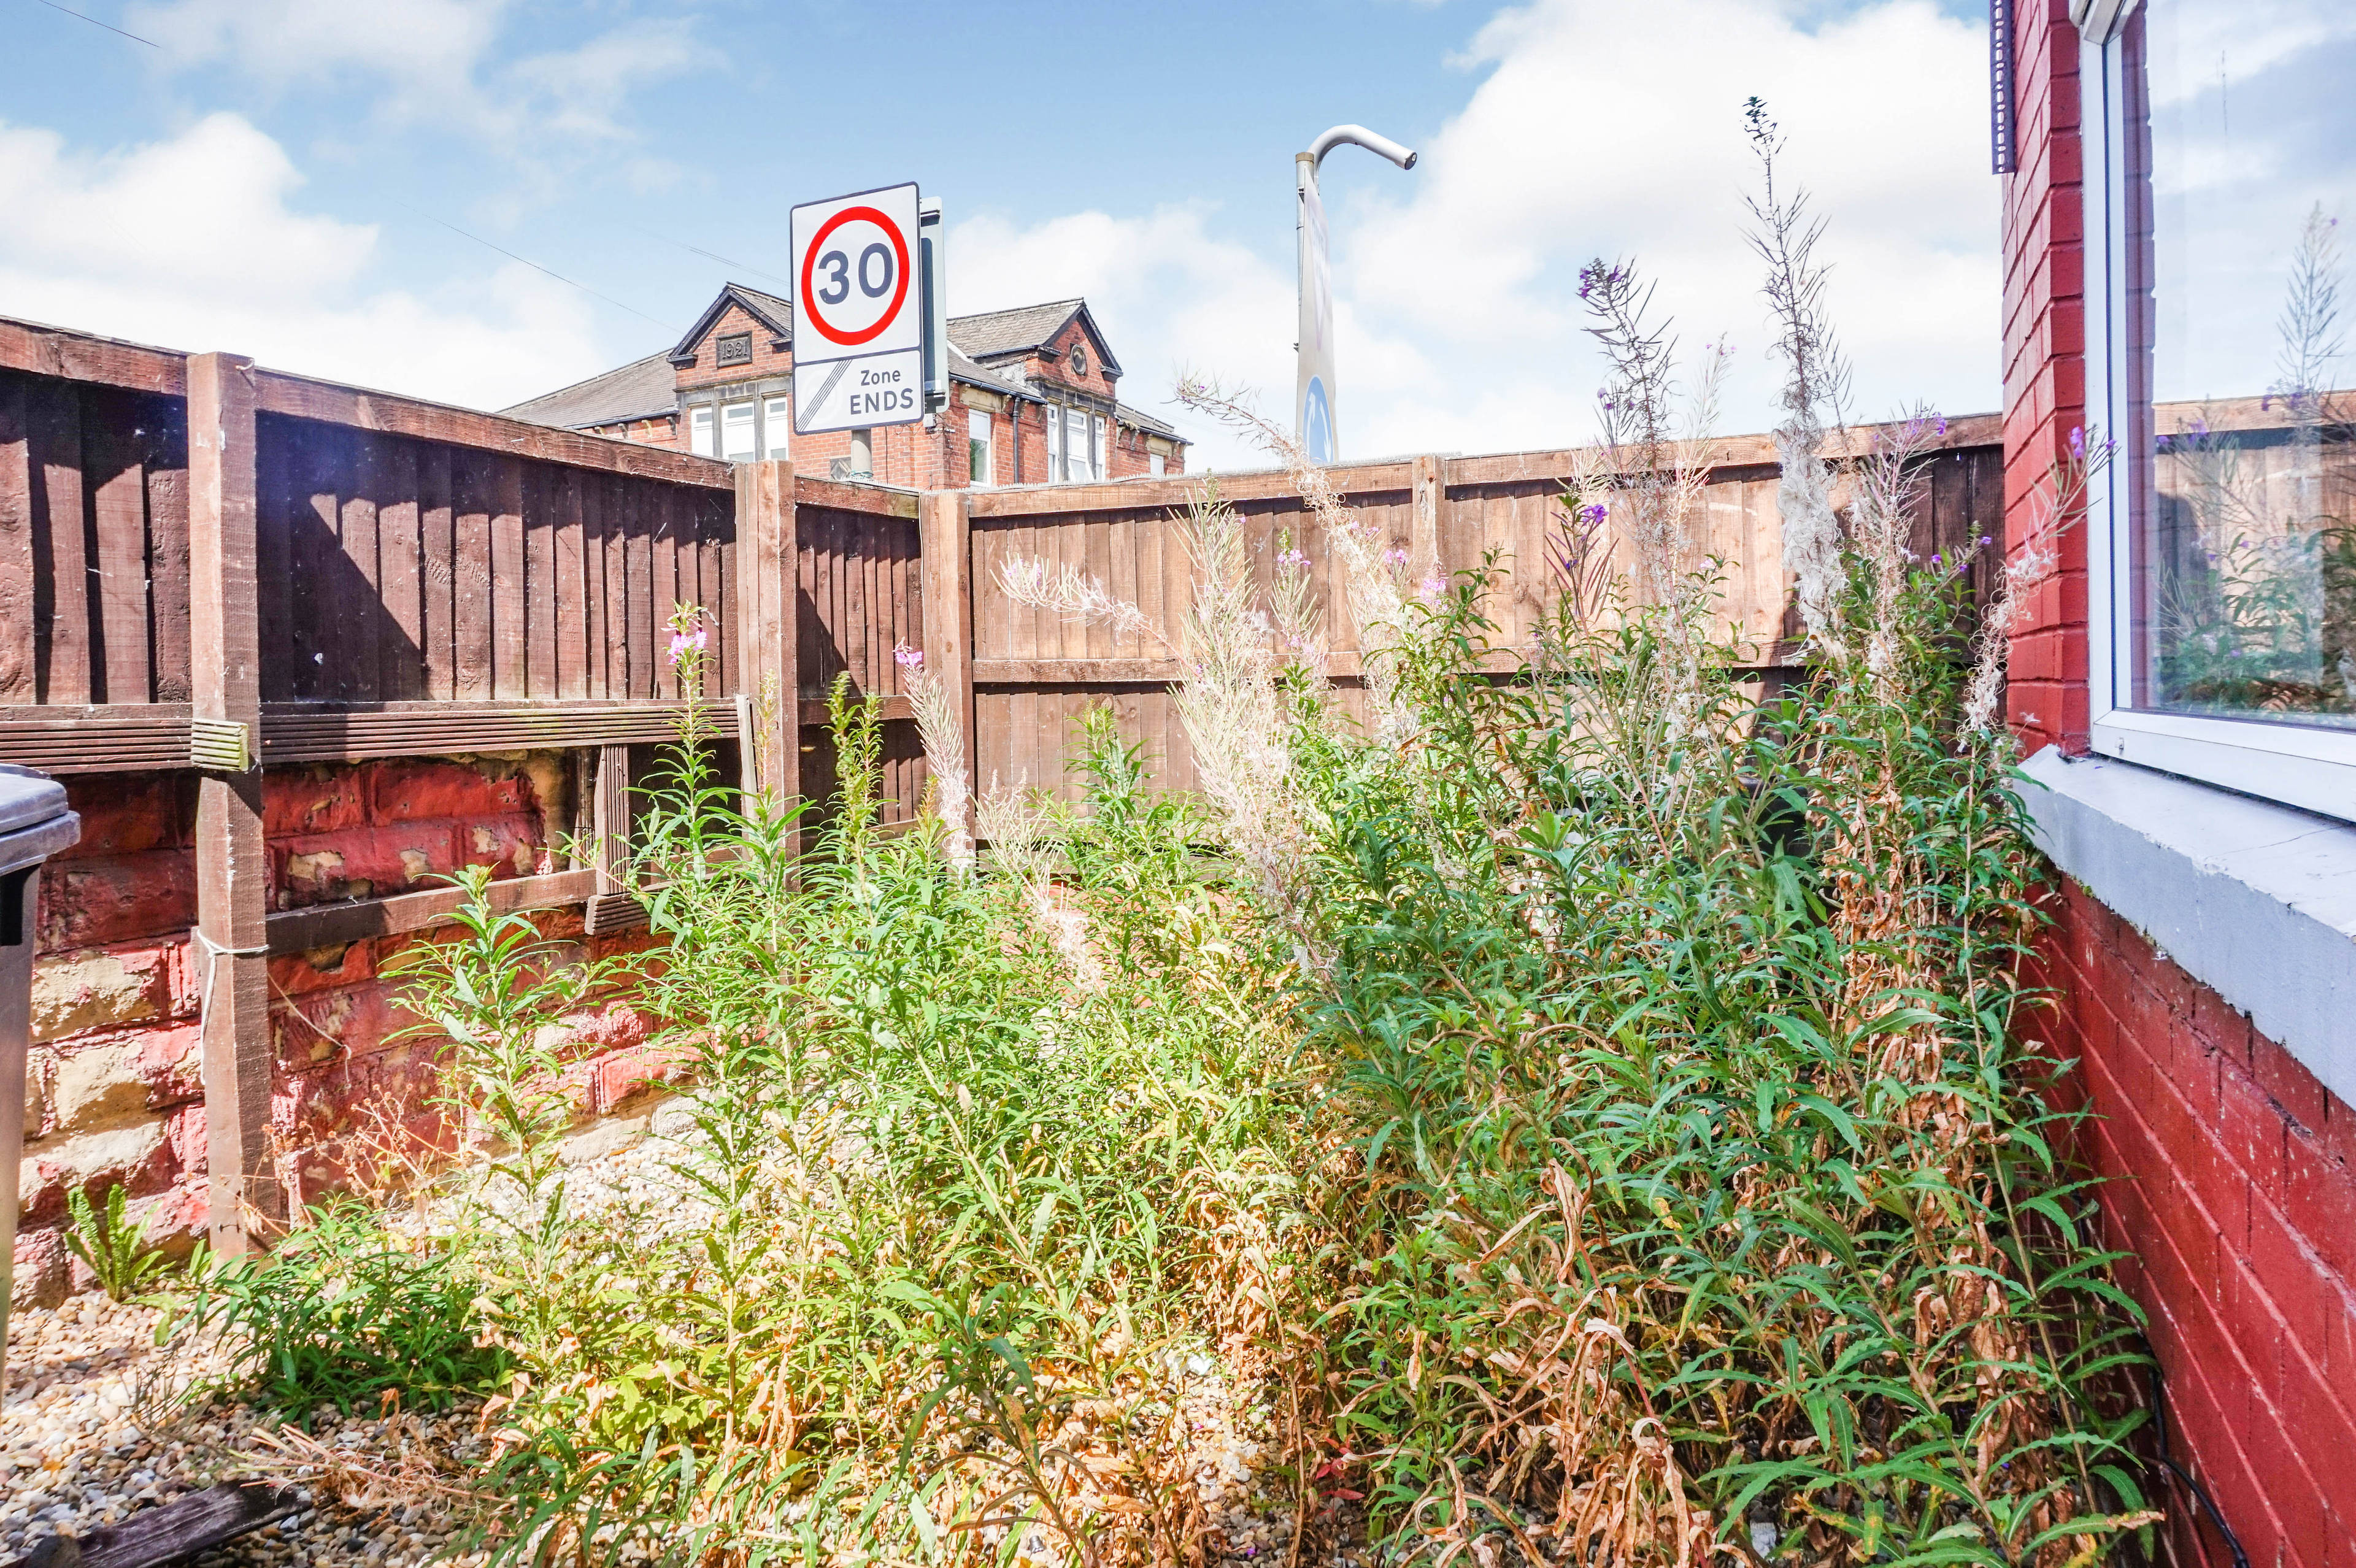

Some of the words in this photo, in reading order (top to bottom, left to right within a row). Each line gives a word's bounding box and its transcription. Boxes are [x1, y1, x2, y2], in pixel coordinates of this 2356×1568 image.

[818, 242, 893, 305] 30
[722, 340, 747, 358] 1921
[860, 369, 901, 386] Zone
[850, 388, 914, 415] ENDS
